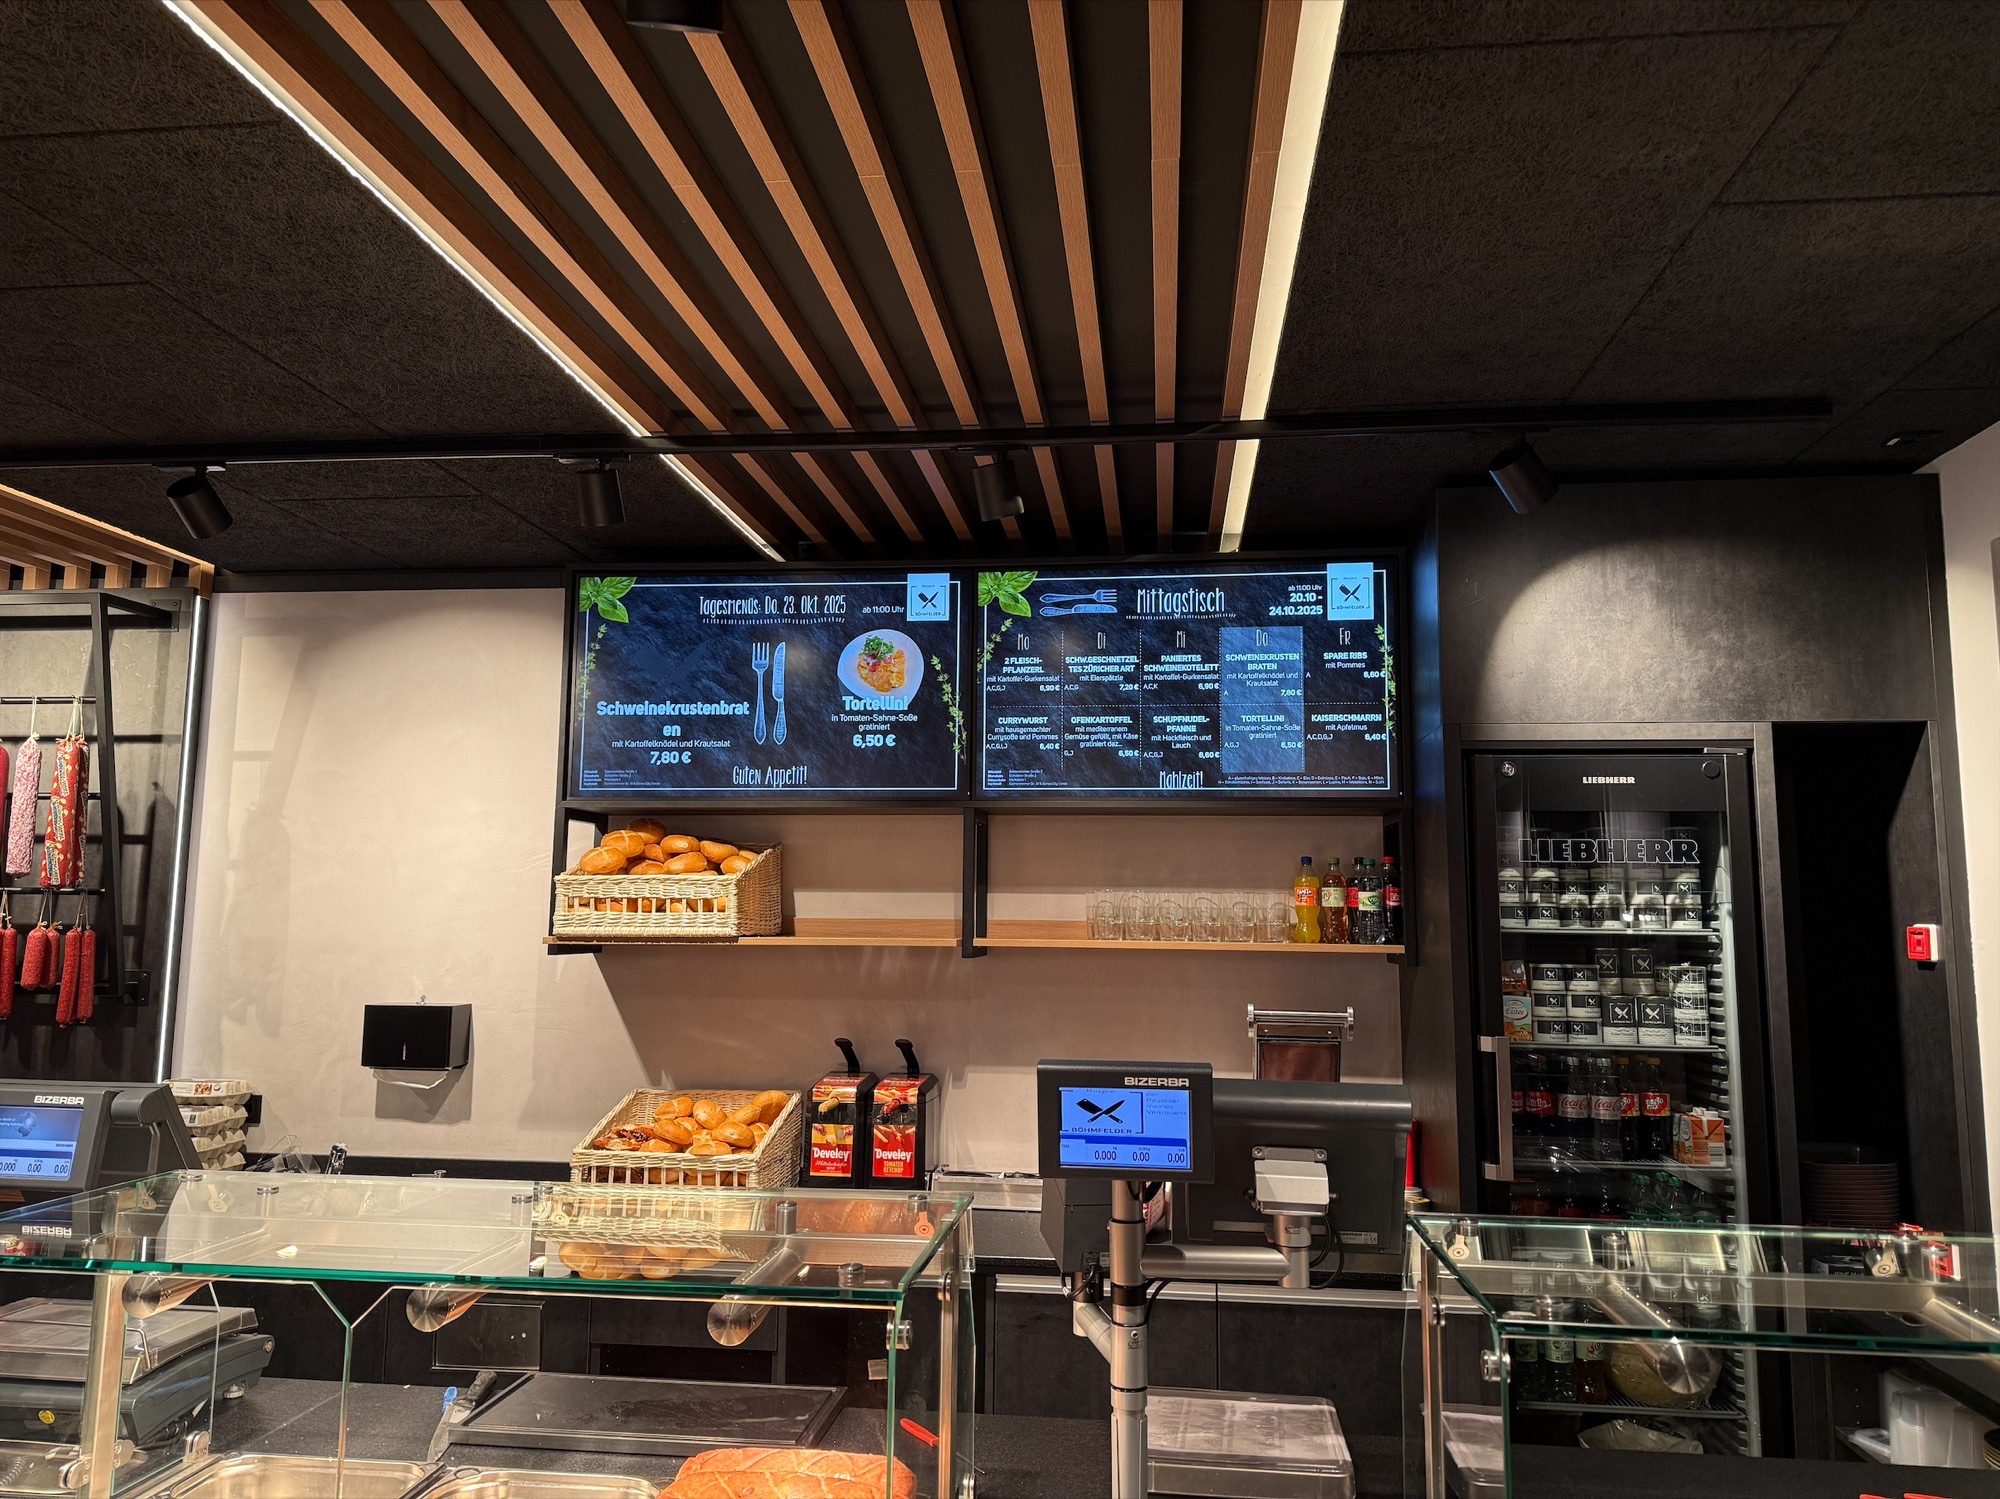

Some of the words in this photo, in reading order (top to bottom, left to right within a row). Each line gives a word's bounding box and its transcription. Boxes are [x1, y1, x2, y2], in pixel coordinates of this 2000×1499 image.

[1136, 587, 1225, 616] Mittagstisch
[1289, 592, 1317, 603] 20.10
[765, 595, 780, 615] Do.
[783, 595, 797, 615] 23.
[801, 594, 820, 614] Okt.
[824, 594, 846, 614] 2025
[862, 605, 872, 614] ab
[873, 605, 890, 613] 11:00
[891, 604, 905, 613] Uhr
[1268, 605, 1323, 616] 24.10.2025
[1017, 633, 1030, 650] Mo
[1097, 632, 1107, 649] Di
[1176, 630, 1186, 648] Mi
[1256, 629, 1269, 647] Do
[1064, 655, 1139, 664] SCHW.GESCHNETZEL
[1160, 654, 1202, 663] PANIERTES
[1225, 653, 1300, 662] SCHWEINEKRUSTEN
[1323, 652, 1349, 660] SPARE
[1002, 666, 1044, 674] PFLANZERL
[1068, 665, 1082, 673] TES
[1083, 664, 1119, 673] ZÜRICHER
[1119, 664, 1136, 672] ART
[1143, 663, 1219, 672] SCHWEINEKOTELETT
[1247, 663, 1278, 671] BRATEN
[986, 675, 996, 683] mit
[997, 675, 1060, 683] Kartoffel-Gurkensalat
[1090, 674, 1124, 682] Eierspätzle
[1154, 673, 1219, 681] Kartoffel-Gurkensalat
[1237, 672, 1286, 680] Kartoffelknödel
[842, 695, 909, 711] Tortellini
[596, 700, 750, 716] Schweinekrustenbrat
[831, 713, 839, 722] in
[839, 713, 918, 722] Tomaten-Sahne-Soße
[998, 716, 1048, 725] CURRYWURST
[1070, 716, 1133, 724] OFENKARTOFFEL
[1152, 715, 1211, 723] SCHUPFNUDEL-
[1241, 714, 1285, 723] TORTELLINI
[1311, 713, 1382, 723] KAISERSCHMARRN
[662, 724, 681, 737] en
[858, 723, 891, 732] gratiniert
[1005, 726, 1051, 734] hausgemachter
[1166, 725, 1197, 733] PFANNE
[1337, 723, 1368, 732] Apfelmus
[987, 734, 1019, 742] Currysoße
[1162, 733, 1199, 741] Hackfleisch
[1199, 733, 1212, 741] und
[1248, 732, 1278, 740] gratiniert
[611, 740, 624, 748] mit
[625, 739, 679, 748] Kartoffelknödel
[679, 739, 693, 748] und
[694, 739, 731, 748] Krautsalat
[852, 734, 883, 749] 6,50
[885, 734, 897, 747] €
[1079, 740, 1107, 748] gratiniert
[1171, 741, 1192, 749] Lauch
[650, 751, 680, 766] 7,80
[681, 751, 692, 764] €
[765, 765, 808, 788] Appetit!
[1159, 770, 1203, 788] Mahlzeit!
[1582, 776, 1636, 784] LIEBHERR
[1518, 838, 1700, 864] LIEBHERR
[1124, 1076, 1190, 1088] BIZERBA
[33, 1095, 84, 1106] BIZERBA
[1071, 1127, 1133, 1135] BÖHMFELDER
[812, 1147, 851, 1162] Develey
[874, 1148, 913, 1163] Develey
[1132, 1151, 1150, 1162] 0,00
[1167, 1152, 1185, 1163] 0,00
[27, 1163, 42, 1174] 0,00
[54, 1164, 69, 1175] 0,00
